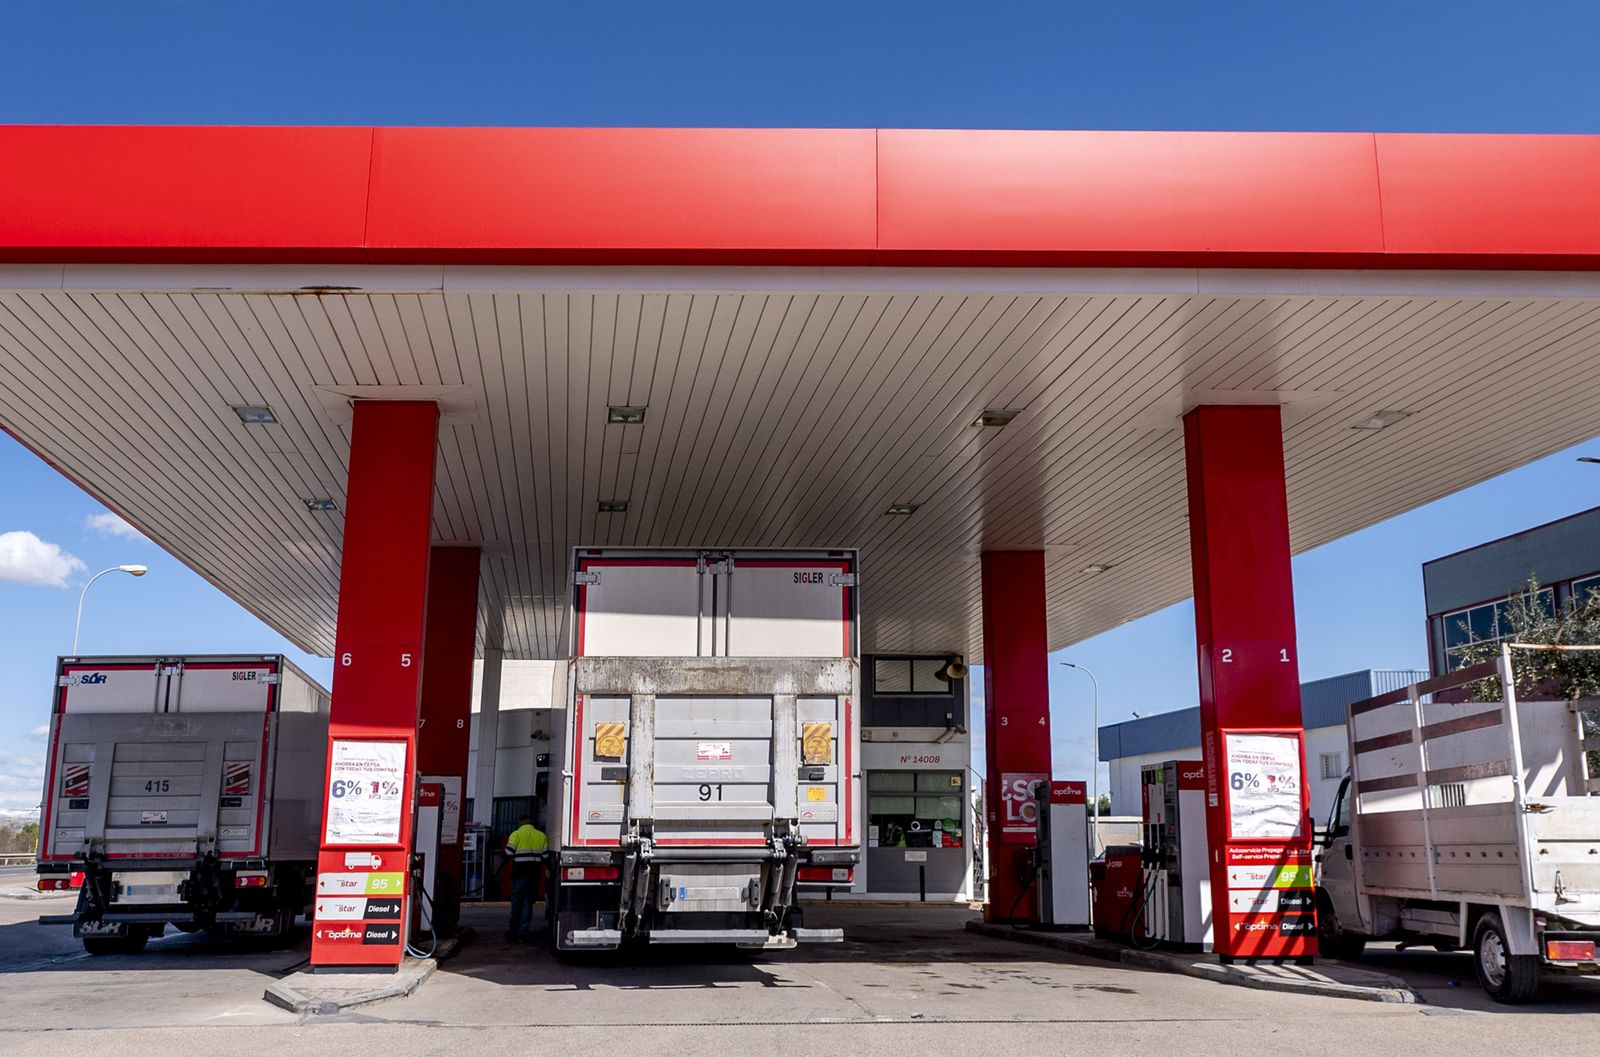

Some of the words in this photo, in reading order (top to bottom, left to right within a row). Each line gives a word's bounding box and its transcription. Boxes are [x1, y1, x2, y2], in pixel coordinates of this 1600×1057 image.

[793, 572, 823, 583] SIGLER
[341, 652, 352, 666] 6
[401, 653, 411, 667] 5
[1222, 649, 1232, 662] 2
[1280, 649, 1290, 662] 1
[232, 671, 256, 681] SIGLER
[419, 719, 425, 728] 7
[457, 719, 464, 729] 8
[1001, 716, 1008, 726] 3
[1039, 716, 1045, 726] 4
[913, 755, 940, 763] 14008
[1231, 772, 1260, 790] 6%
[145, 780, 170, 793] 415
[332, 780, 362, 798] 6%
[699, 784, 722, 801] 91
[1053, 788, 1082, 796] optima
[1281, 871, 1296, 882] 95
[371, 879, 388, 889] 95
[1245, 922, 1278, 931] optima
[328, 930, 362, 940] optima
